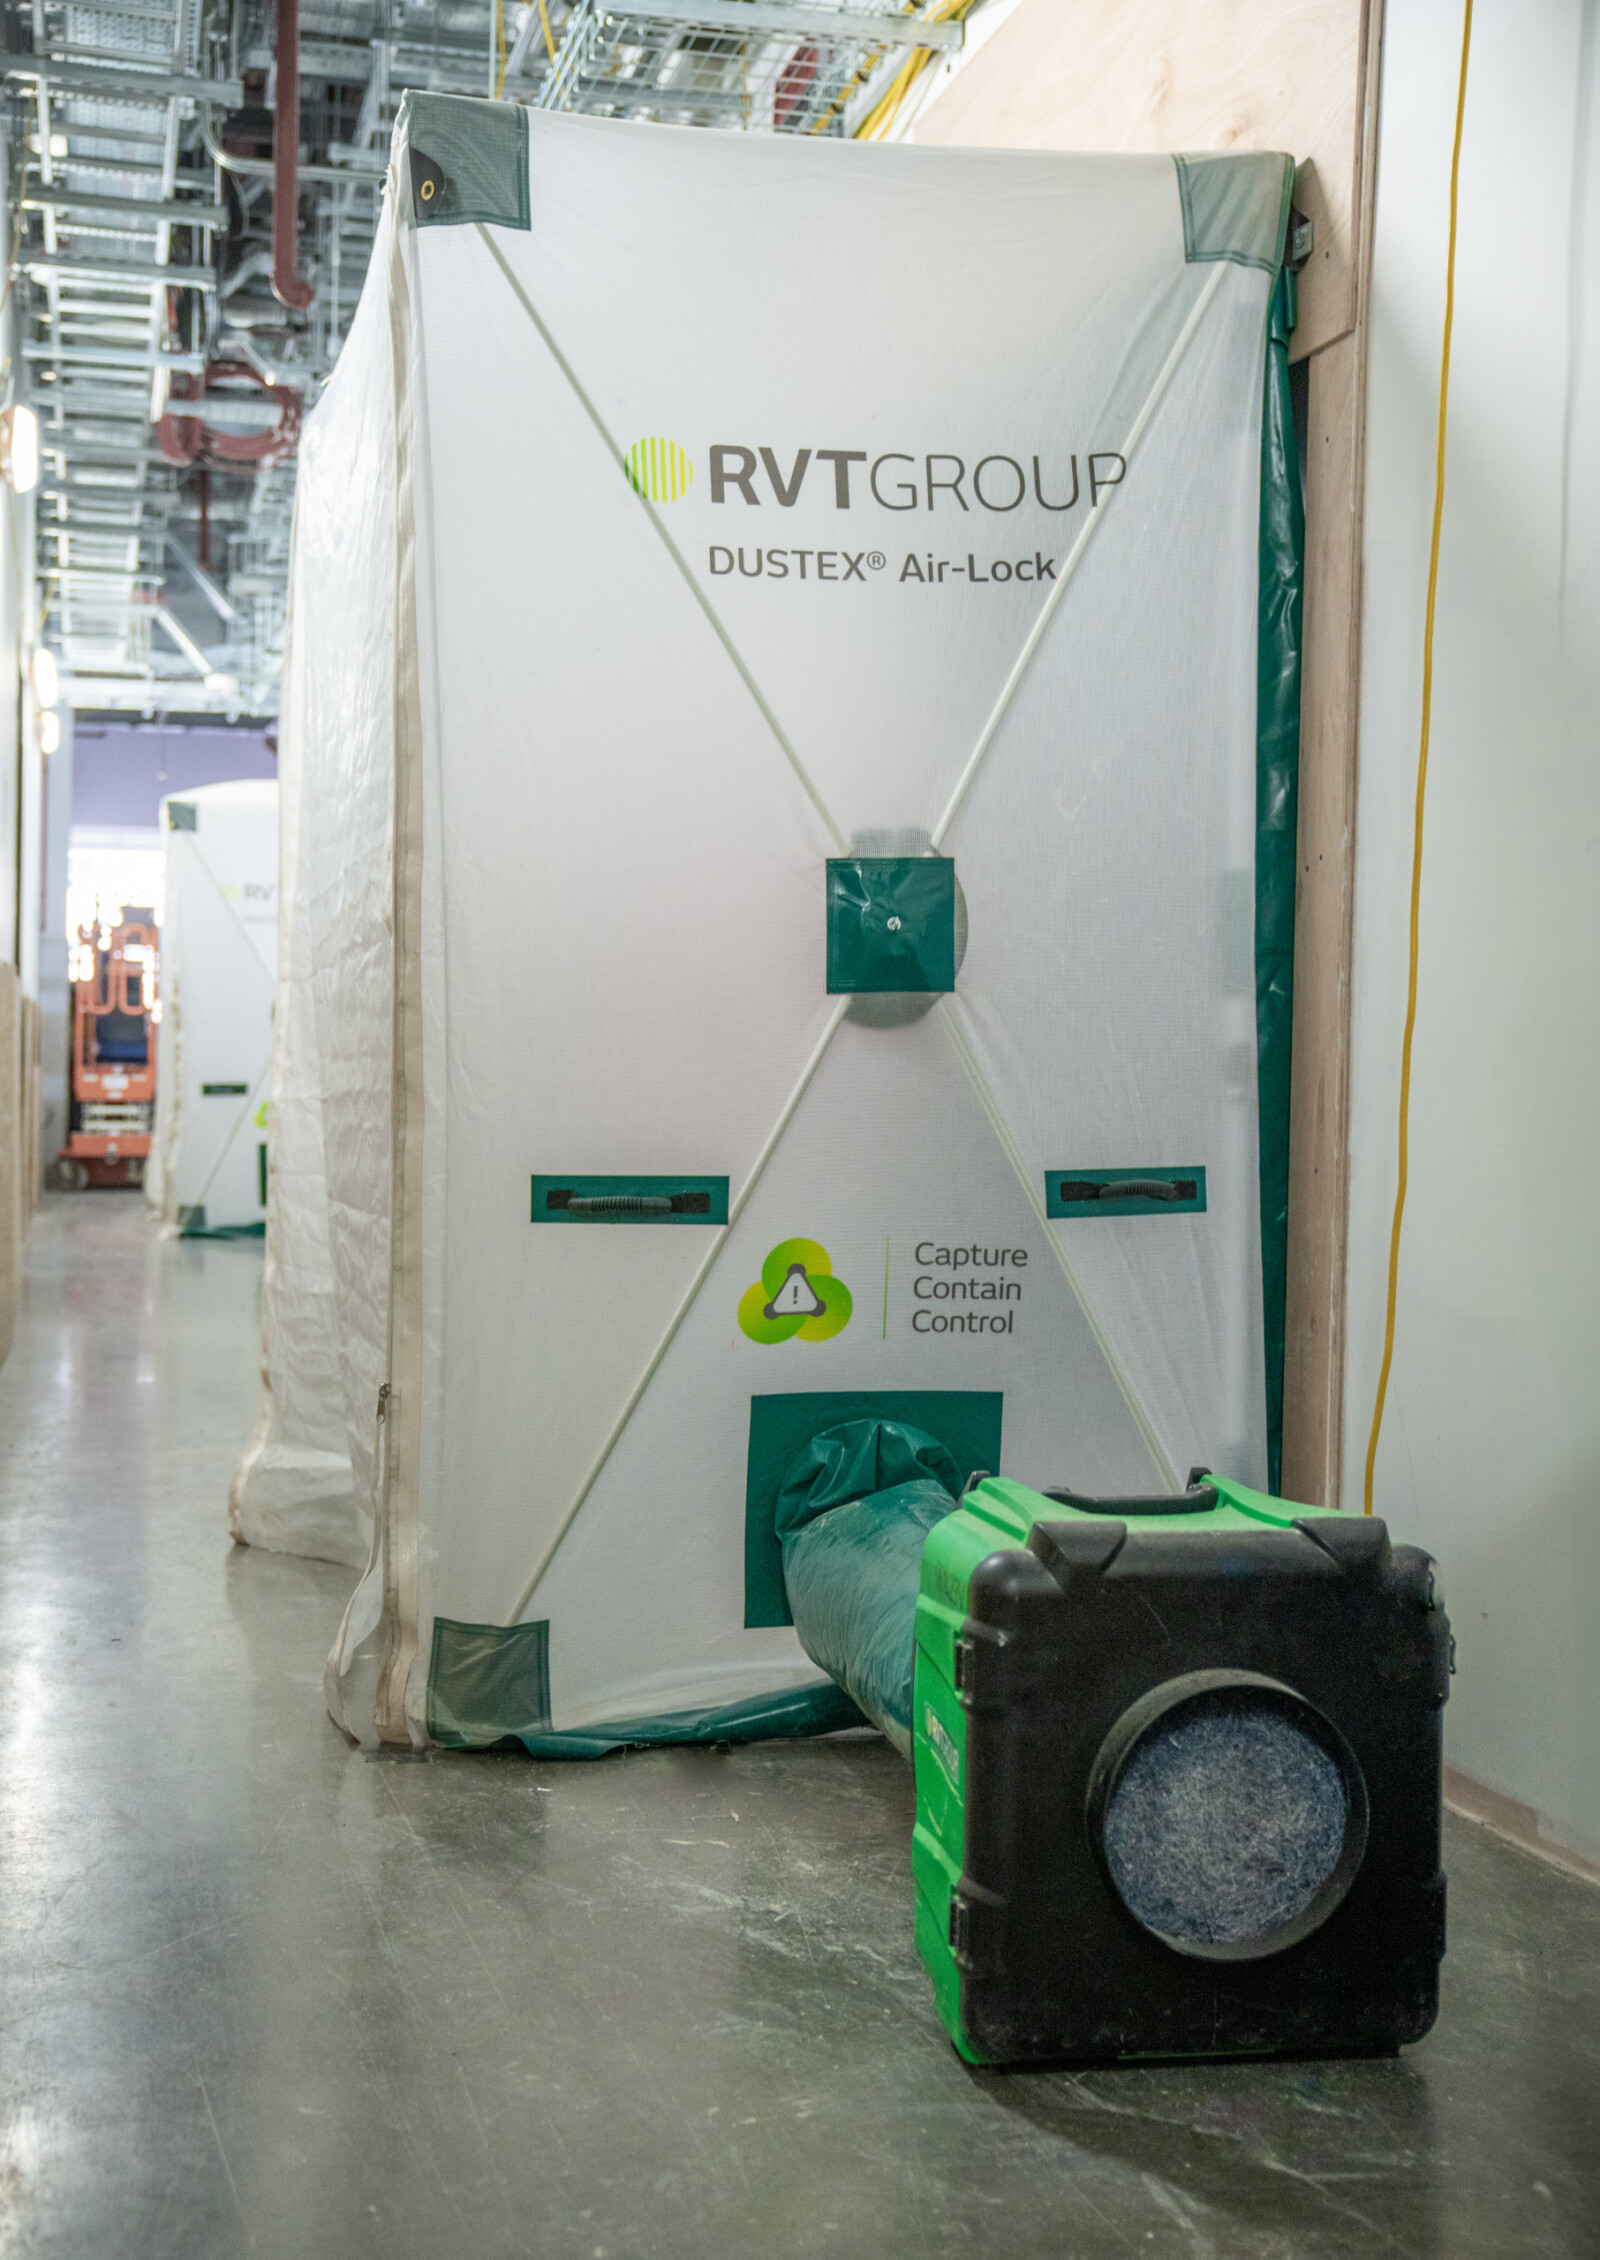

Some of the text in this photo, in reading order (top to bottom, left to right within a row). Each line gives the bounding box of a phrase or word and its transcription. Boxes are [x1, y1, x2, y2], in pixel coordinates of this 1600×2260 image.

[709, 444, 1128, 512] RVTGROUP
[709, 545, 1057, 583] DUSTEX® Air-Lock
[914, 1242, 1028, 1270] Capture
[913, 1276, 1022, 1301] Contain
[911, 1309, 1014, 1334] Control
